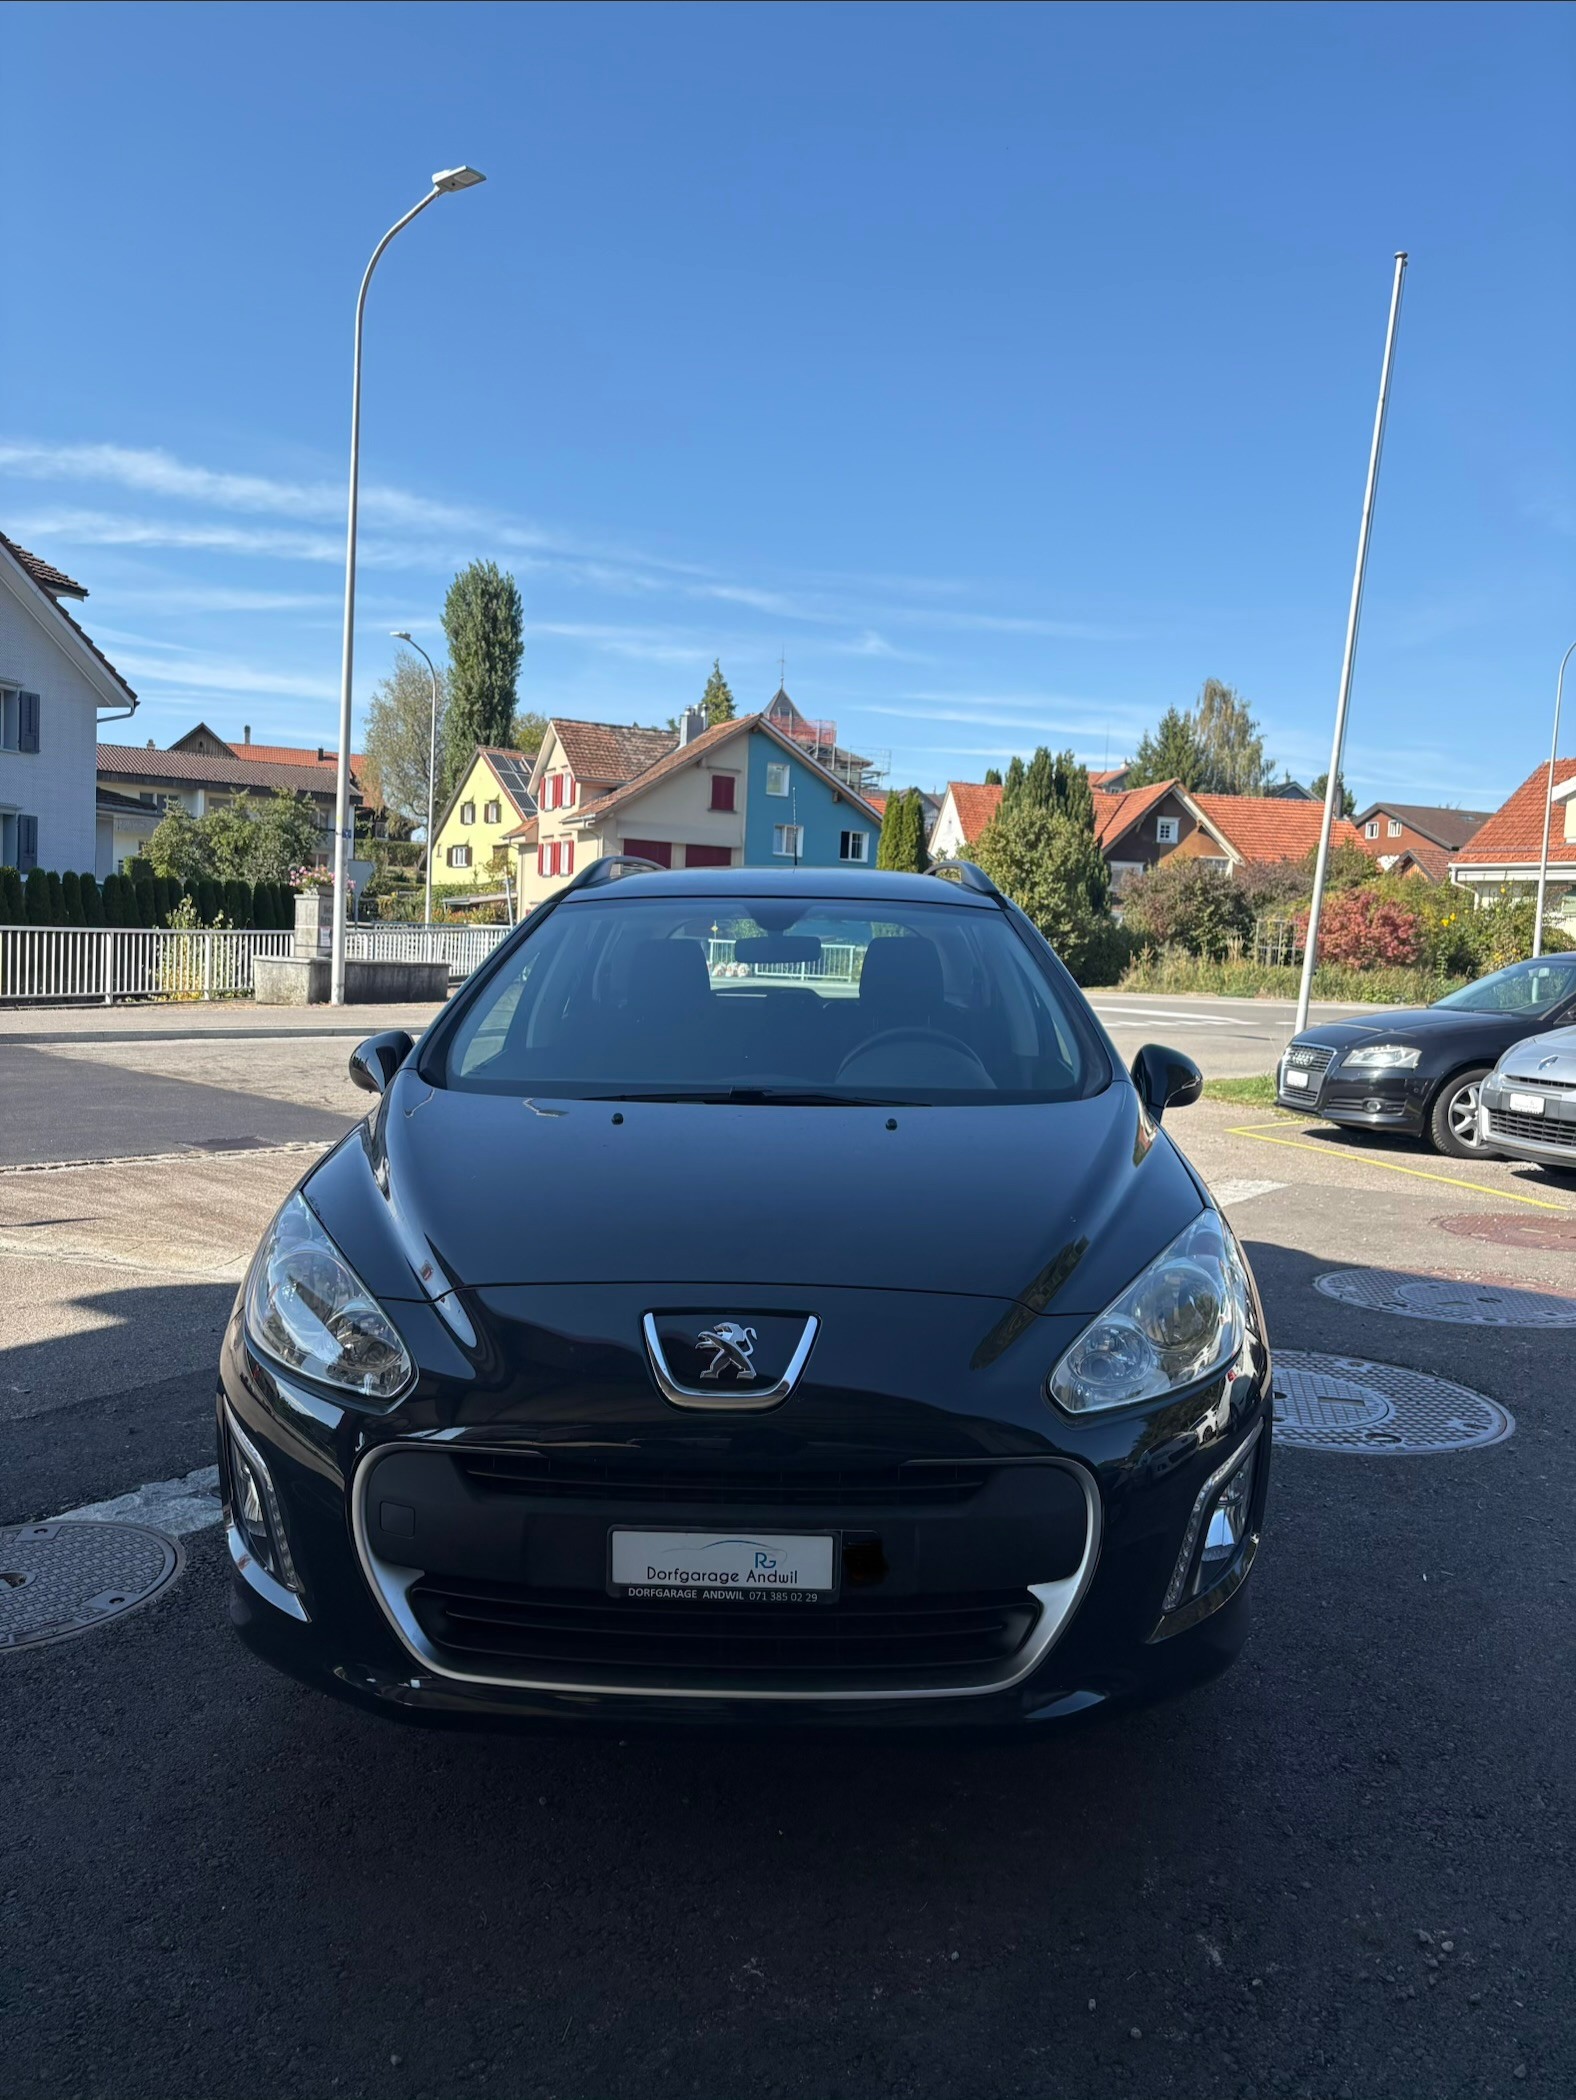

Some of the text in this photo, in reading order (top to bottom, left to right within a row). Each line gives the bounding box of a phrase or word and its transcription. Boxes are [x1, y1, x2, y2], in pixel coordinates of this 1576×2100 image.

[647, 1566, 798, 1584] Dorfgarage Andwil
[628, 1587, 818, 1602] DORFGARAGE ANDWIL 071 385 02 29
